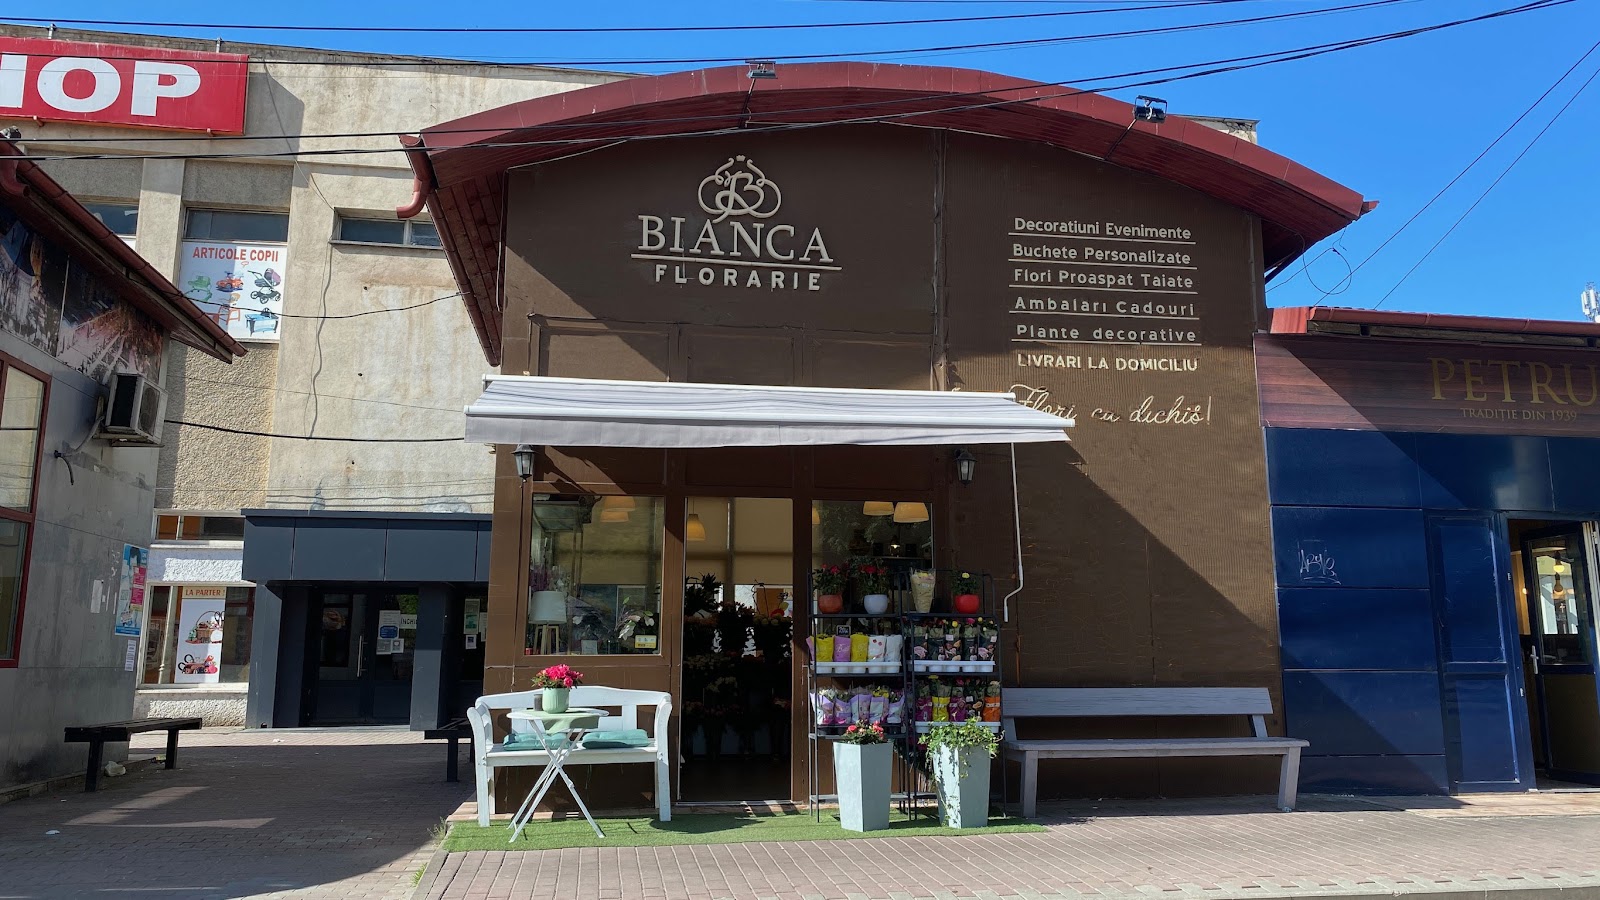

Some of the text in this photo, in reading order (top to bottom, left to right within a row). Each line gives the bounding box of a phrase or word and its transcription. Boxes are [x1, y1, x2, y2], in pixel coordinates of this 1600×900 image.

[1014, 217, 1192, 240] Decoratiuni Evenimente
[638, 214, 834, 264] BIANCA
[192, 246, 279, 263] ARTICOLE COPII
[1012, 243, 1192, 265] Buchete Personalizate
[655, 264, 821, 291] FLORARIE
[1014, 268, 1194, 288] Flori Proaspat Taiate
[1116, 300, 1195, 316] Cadouri
[1016, 324, 1197, 342] Plante decorative
[1017, 353, 1198, 372] LIVRARI LA DOMICILIU
[1427, 357, 1599, 407] PETRU
[1521, 409, 1546, 421] DIN
[1551, 409, 1578, 422] 1939
